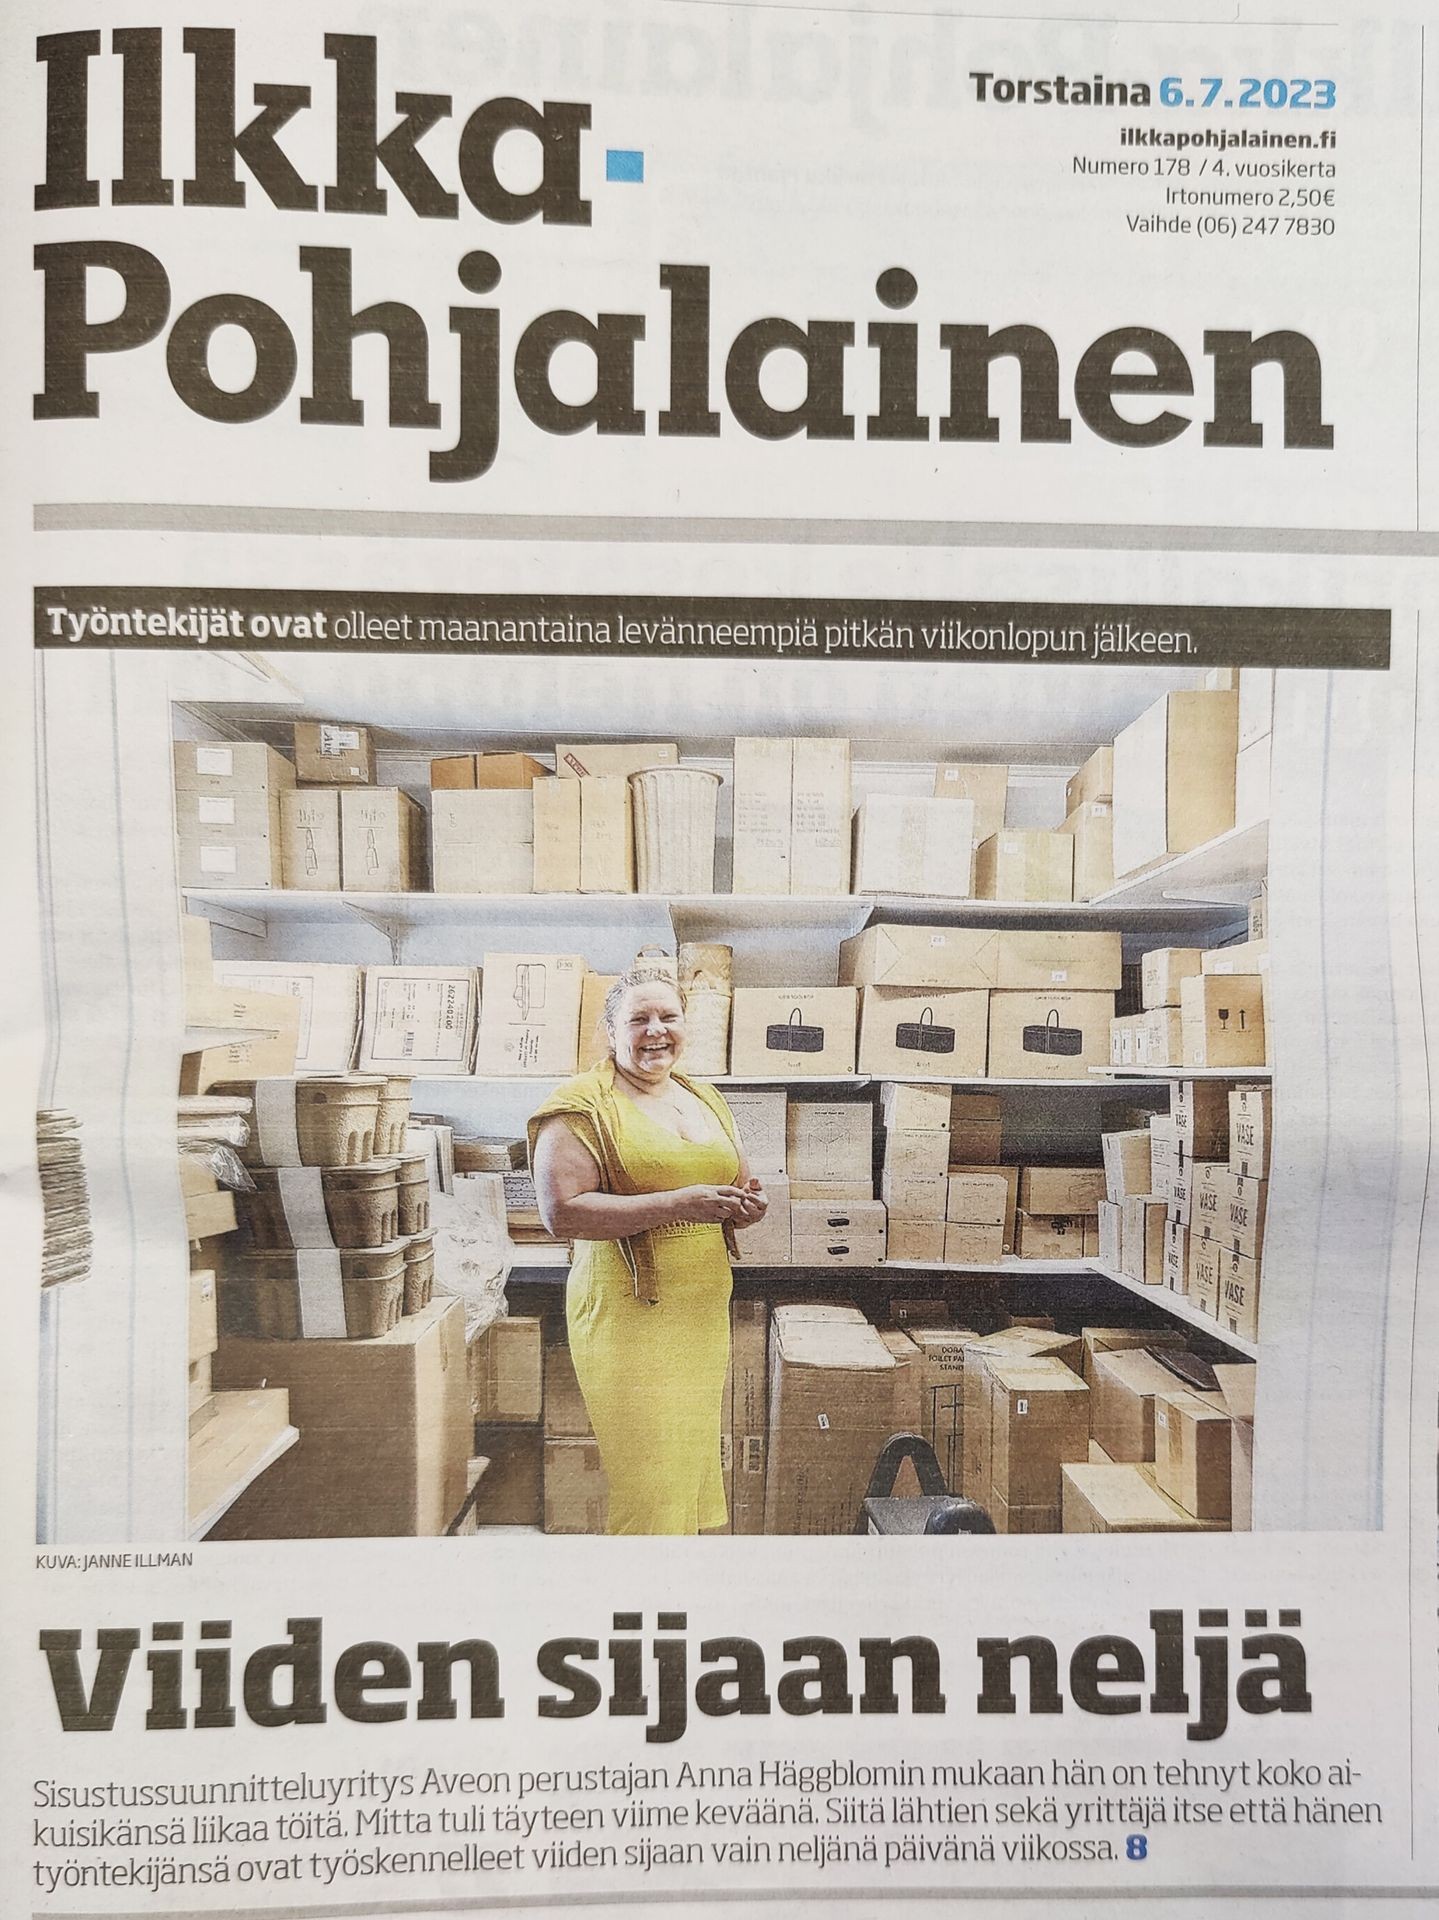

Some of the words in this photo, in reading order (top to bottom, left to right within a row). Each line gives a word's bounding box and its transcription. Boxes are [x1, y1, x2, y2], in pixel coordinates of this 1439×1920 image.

[969, 72, 1150, 106] Torstaina
[1160, 77, 1336, 109] 6.7.2023
[1121, 128, 1336, 151] ilkkapohjalainen.fi
[1074, 156, 1149, 175] Numero
[1155, 158, 1190, 176] 178
[1199, 159, 1207, 176] /
[1212, 159, 1229, 176] 4.
[1235, 159, 1335, 178] vuosikerta
[1167, 187, 1273, 206] Irtonumero
[1279, 189, 1335, 208] 2,50€
[1127, 215, 1191, 233] Vaihde
[1197, 216, 1236, 238] (06)
[1243, 217, 1279, 234] 247
[1285, 218, 1335, 235] 7830
[33, 240, 1334, 483] Pohjalainen
[47, 606, 244, 643] Työntekijät
[250, 612, 327, 638] ovat
[335, 611, 412, 640] olleet
[420, 614, 611, 643] maanantaina
[618, 615, 818, 652] levänneempiä
[825, 619, 914, 653] pitkän
[921, 620, 1086, 657] viikonlopun
[1091, 623, 1197, 658] jälkeen.
[1236, 1123, 1255, 1146] VASE
[1199, 1192, 1217, 1212] VASE
[1230, 1203, 1248, 1227] VASE
[1196, 1262, 1213, 1285] VASE
[1224, 1279, 1245, 1306] VASE
[36, 1555, 80, 1569] KUVA:
[82, 1554, 131, 1572] JANNE
[135, 1553, 192, 1567] ILLMAN
[39, 1618, 504, 1732] Viiden
[537, 1612, 946, 1744] sijaan
[977, 1609, 1312, 1742] neljä
[34, 1770, 413, 1812] Sisustussuunnitteluyritys
[421, 1768, 510, 1794] Aveon
[518, 1762, 669, 1799] perustajan
[676, 1762, 752, 1788] Anna
[760, 1760, 925, 1793] Häggblomin
[933, 1759, 1045, 1786] mukaan
[1052, 1759, 1105, 1785] hän
[1113, 1766, 1146, 1785] on
[1153, 1759, 1250, 1792] tehnyt
[1257, 1759, 1321, 1786] koko
[1328, 1758, 1361, 1785] ai-
[34, 1817, 186, 1847] kuisikänsä
[193, 1815, 269, 1844] liikaa
[276, 1810, 348, 1840] töitä.
[356, 1808, 431, 1836] Mitta
[439, 1805, 485, 1832] tuli
[493, 1804, 604, 1838] täyteen
[612, 1800, 688, 1828] viime
[696, 1798, 818, 1825] keväänä.
[827, 1797, 885, 1824] Siitä
[893, 1797, 988, 1823] lähtien
[996, 1796, 1058, 1824] sekä
[1065, 1796, 1166, 1829] yrittäjä
[1174, 1796, 1222, 1823] itse
[1230, 1797, 1287, 1823] että
[1294, 1796, 1382, 1824] hänen
[33, 1855, 230, 1893] työntekijänsä
[237, 1854, 302, 1881] ovat
[309, 1844, 524, 1885] työskennelleet
[532, 1840, 617, 1868] viiden
[625, 1838, 703, 1872] sijaan
[711, 1836, 770, 1863] vain
[779, 1835, 877, 1869] neljänä
[885, 1834, 995, 1868] päivänä
[1002, 1834, 1118, 1861] viikossa.
[1126, 1835, 1147, 1860] 8
